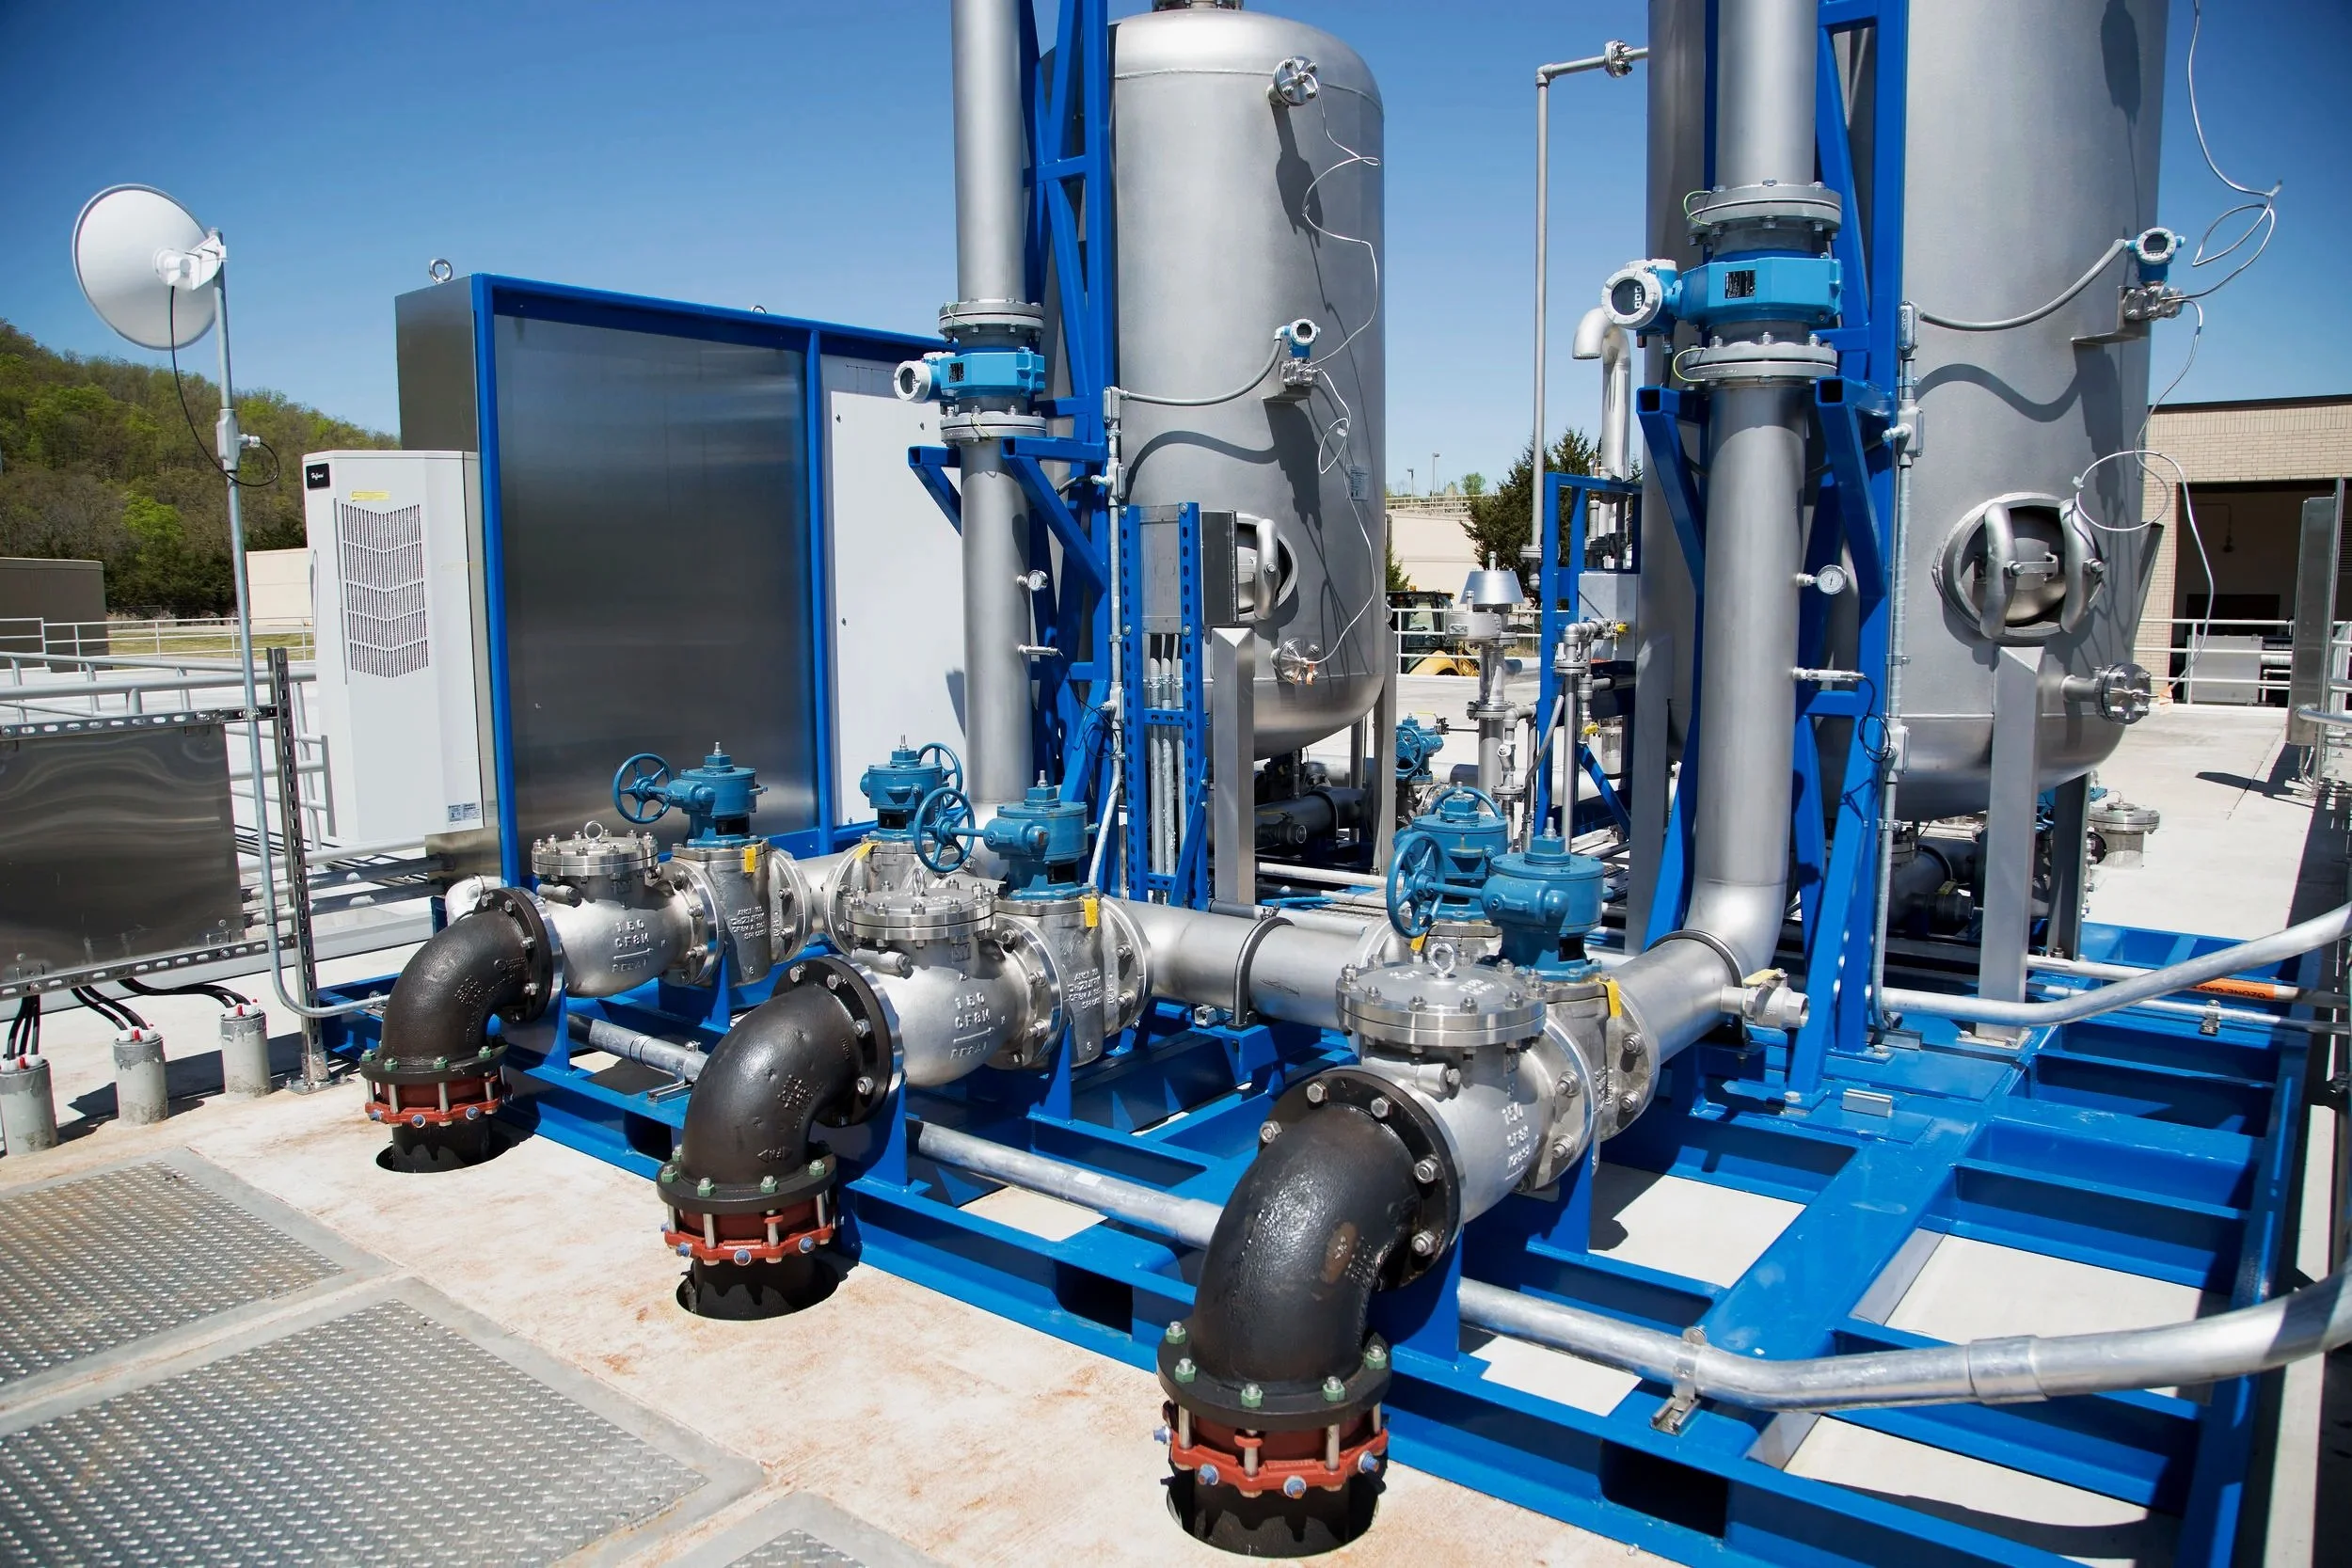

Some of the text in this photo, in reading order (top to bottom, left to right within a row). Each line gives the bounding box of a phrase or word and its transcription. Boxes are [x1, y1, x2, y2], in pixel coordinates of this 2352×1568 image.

[615, 919, 645, 933] 150
[614, 932, 649, 948] CF8M
[954, 992, 985, 1009] 150
[2227, 988, 2266, 999] OZONE
[954, 1007, 990, 1029] CF8M
